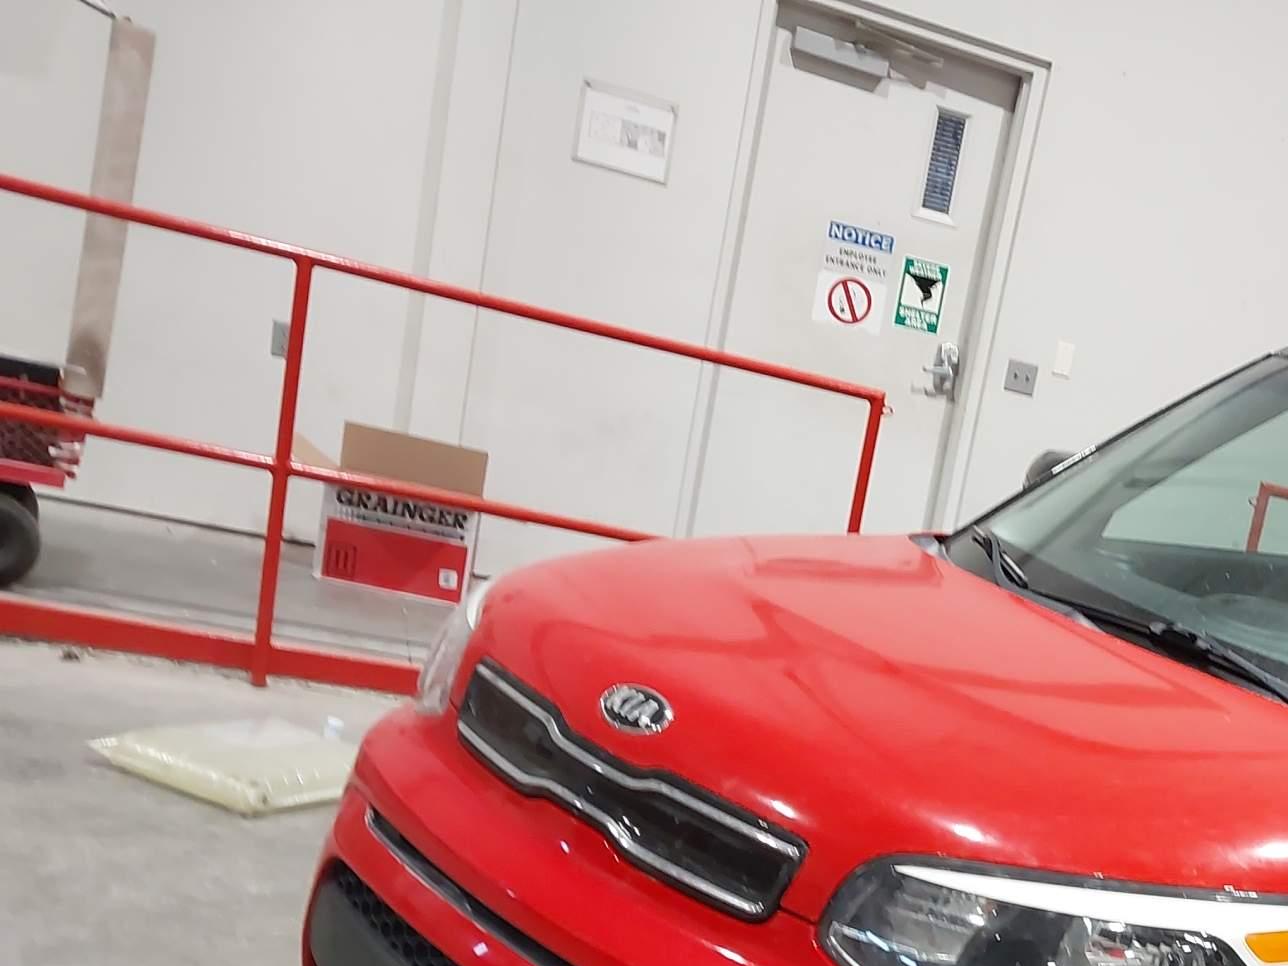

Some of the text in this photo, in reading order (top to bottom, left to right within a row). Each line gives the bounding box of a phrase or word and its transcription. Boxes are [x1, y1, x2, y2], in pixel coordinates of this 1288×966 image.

[829, 222, 893, 251] NOTICE
[825, 255, 887, 278] ENTRANCE ONLY
[335, 488, 468, 530] GRAINGER
